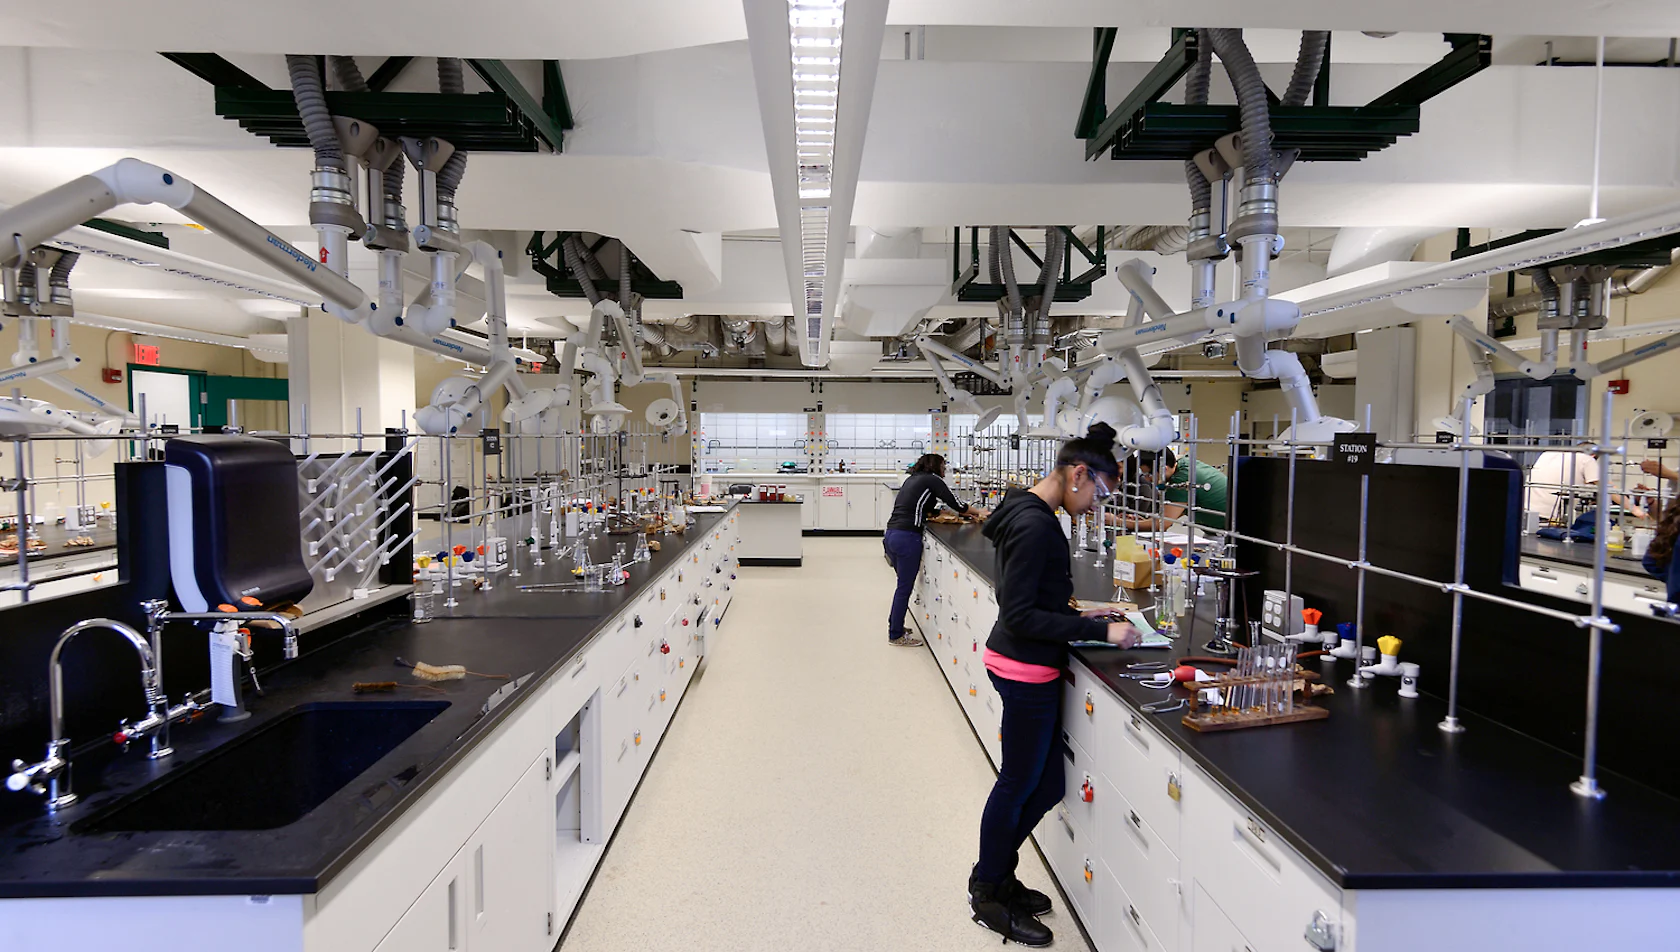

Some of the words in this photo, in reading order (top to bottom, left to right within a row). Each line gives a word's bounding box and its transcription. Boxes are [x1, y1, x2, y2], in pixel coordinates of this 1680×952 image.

[267, 235, 317, 272] Nederman
[432, 337, 464, 353] Nederman
[1339, 443, 1368, 453] STATION
[1346, 455, 1359, 464] #19
